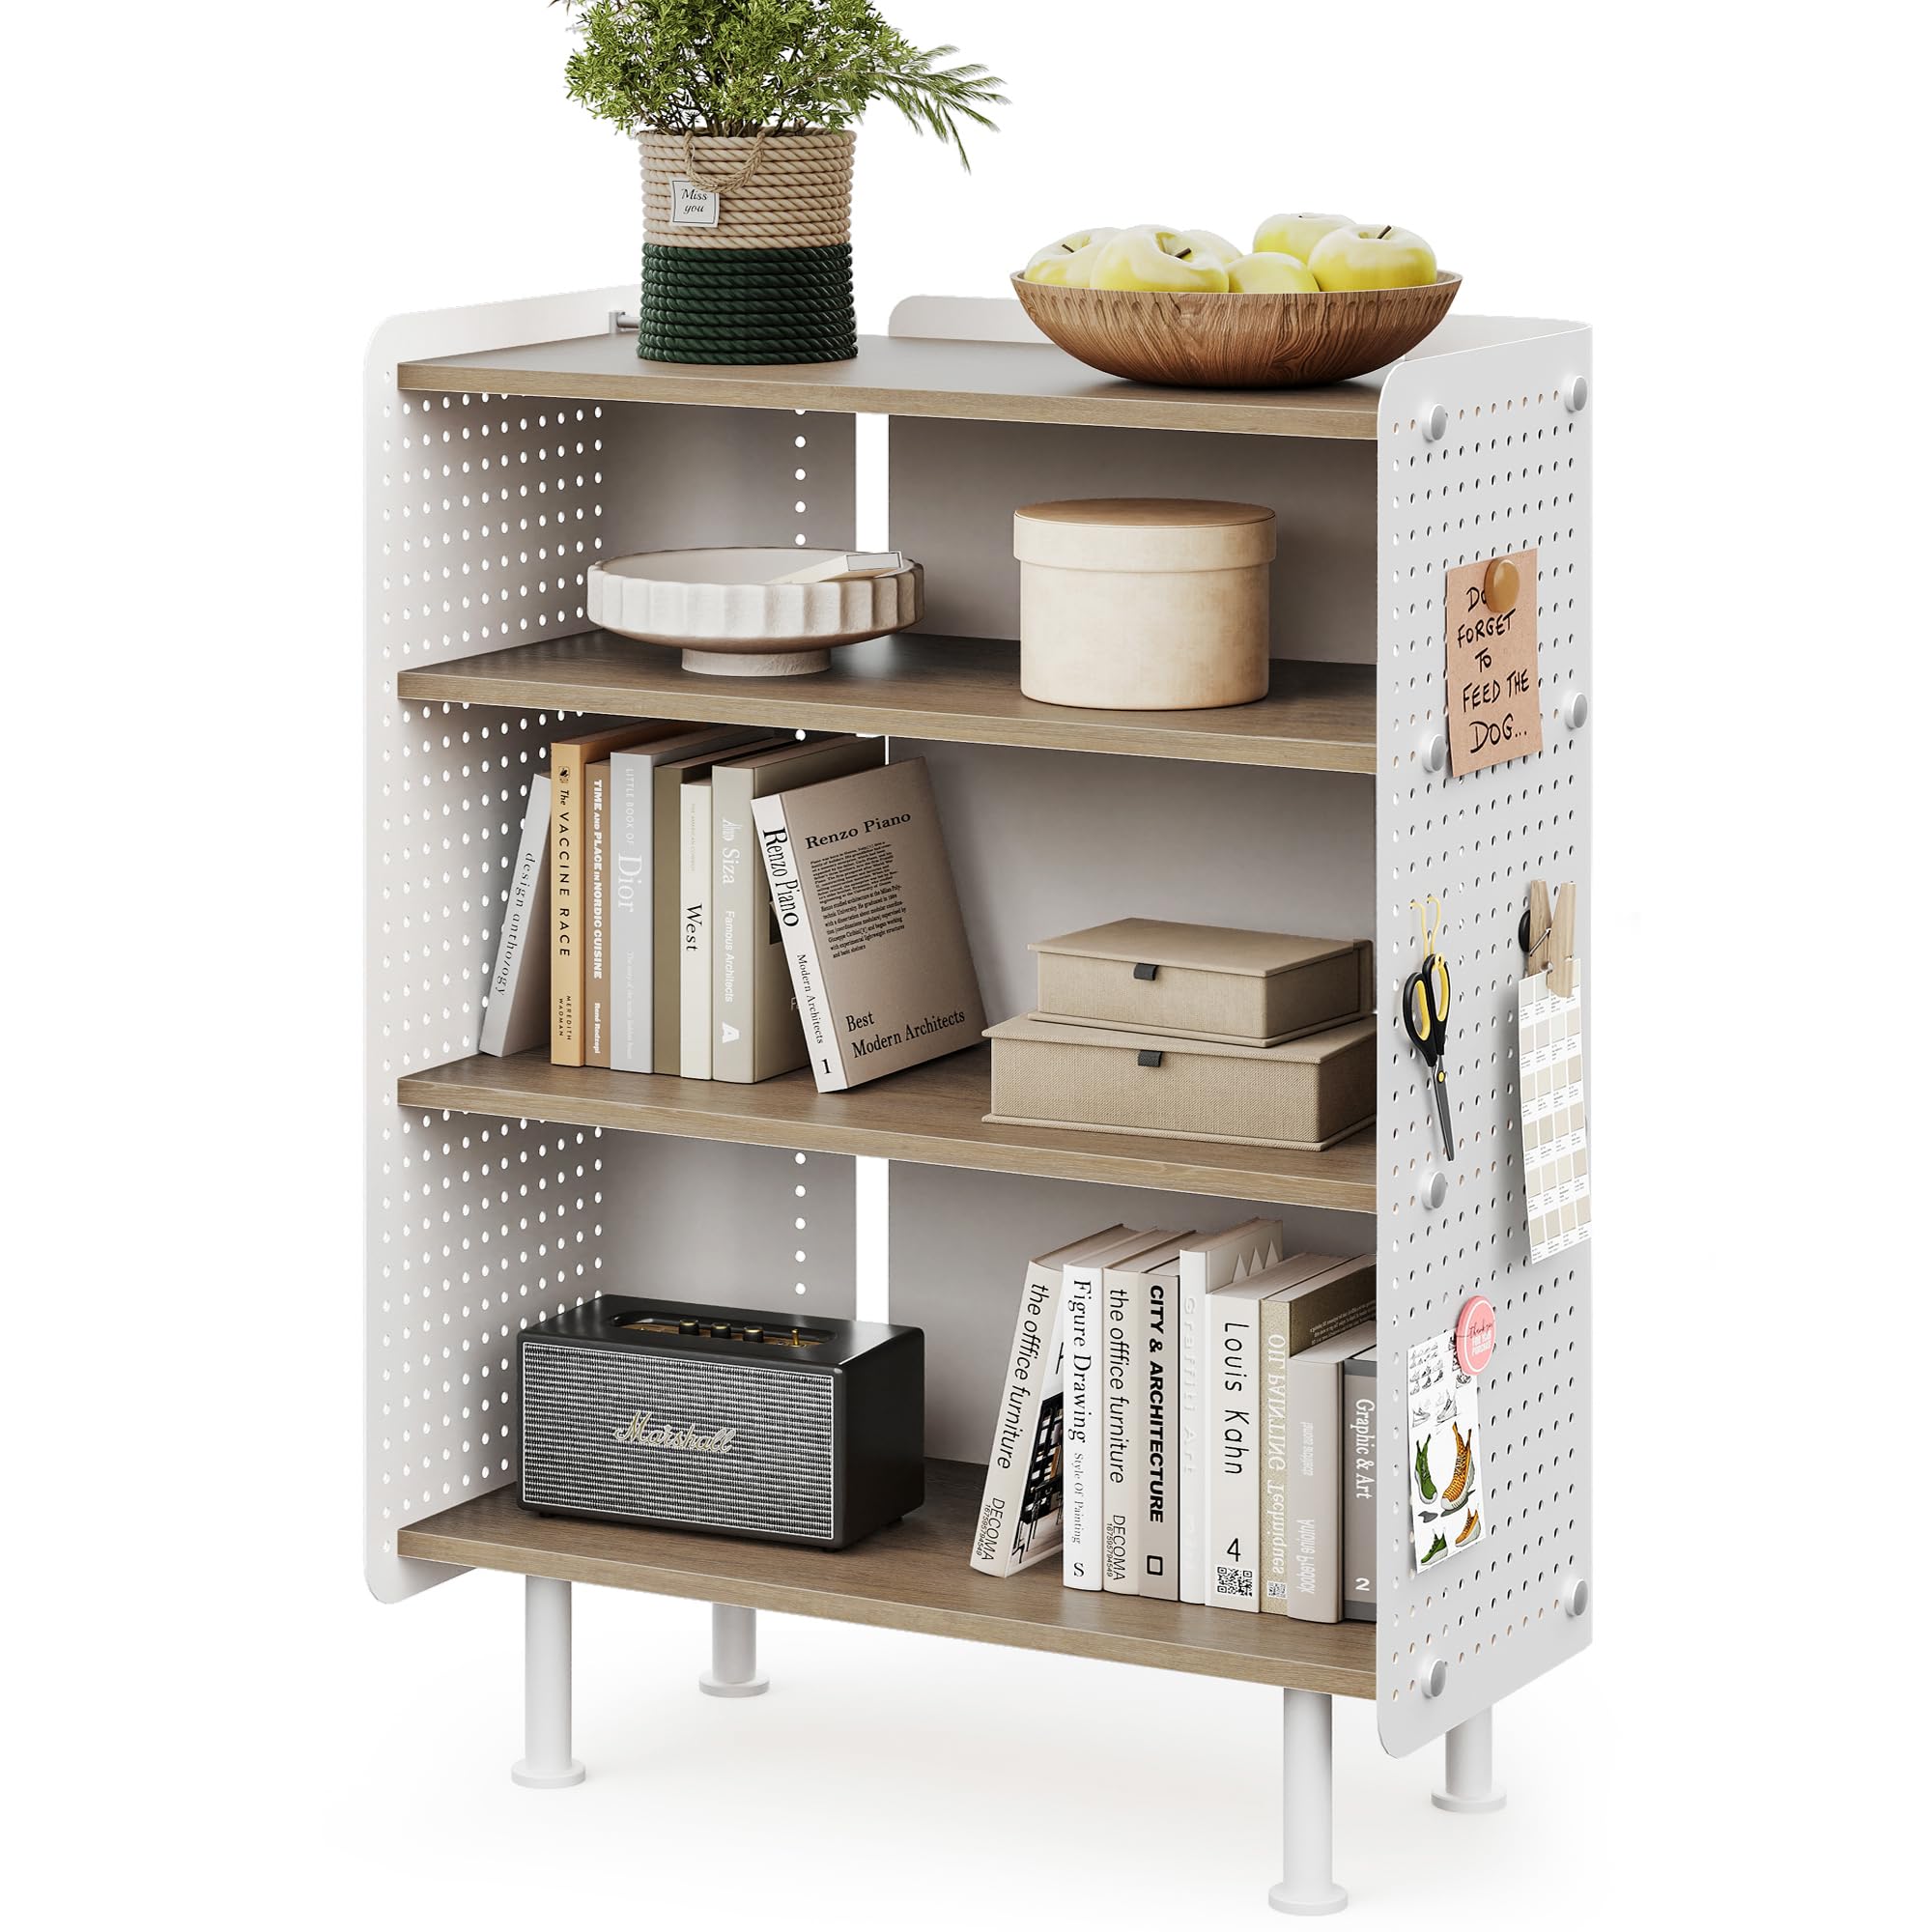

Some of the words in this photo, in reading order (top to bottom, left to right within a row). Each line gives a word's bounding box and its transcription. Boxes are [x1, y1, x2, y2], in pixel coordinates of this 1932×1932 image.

[681, 188, 708, 201] Miss
[683, 205, 704, 214] you
[1457, 609, 1517, 649] FORGET
[1474, 647, 1492, 672] TO
[1462, 679, 1500, 713] FEED
[1506, 668, 1530, 698] THE
[1468, 713, 1527, 753] DOG...
[560, 789, 569, 806] The
[593, 780, 603, 810] TIME
[625, 769, 634, 798] LITTLE
[593, 832, 603, 870] PLACE
[805, 827, 859, 850] Renzo
[863, 811, 912, 834] Piano
[558, 811, 570, 896] VACCINE
[593, 871, 600, 881] IN
[722, 847, 740, 884] Siza
[515, 852, 535, 907] design
[617, 853, 642, 913] Dior
[762, 826, 788, 877] Renzo
[776, 878, 801, 928] Piano
[593, 882, 603, 927] NORDIC
[559, 908, 570, 955] RACE
[685, 903, 703, 952] West
[724, 910, 735, 951] Famous
[496, 913, 521, 995] anthology
[593, 929, 603, 979] CUISINE
[724, 953, 735, 1002] Architects
[796, 953, 812, 993] Modern
[807, 994, 823, 1044] Architects
[845, 1011, 875, 1033] Best
[850, 1029, 903, 1059] Modern
[904, 1008, 966, 1041] Architects
[820, 1058, 833, 1075] 1
[1027, 1284, 1050, 1316] the
[1068, 1280, 1092, 1347] Figure
[1110, 1289, 1129, 1321] the
[1150, 1285, 1164, 1334] CITY
[1150, 1338, 1163, 1353] &
[1183, 1297, 1196, 1412] Graffiti
[1224, 1322, 1250, 1392] Louis
[1068, 1355, 1093, 1443] Drawing
[612, 1409, 737, 1454] Marshall
[997, 1385, 1031, 1469] furniture
[1110, 1397, 1129, 1484] furniture
[1150, 1360, 1164, 1523] ARCHITECTURE
[1224, 1409, 1250, 1474] Kahn
[1350, 1399, 1376, 1455] Graphic
[1071, 1453, 1084, 1480] Style
[1183, 1427, 1196, 1474] Art
[1355, 1458, 1375, 1471] &
[1074, 1483, 1084, 1496] Of
[1355, 1472, 1376, 1499] Art
[981, 1497, 1005, 1561] DECOMA
[1072, 1500, 1084, 1545] Painting
[1073, 1562, 1085, 1577] S
[1113, 1515, 1126, 1580] DECOMA
[1227, 1538, 1241, 1562] 4
[1355, 1577, 1371, 1592] 2
